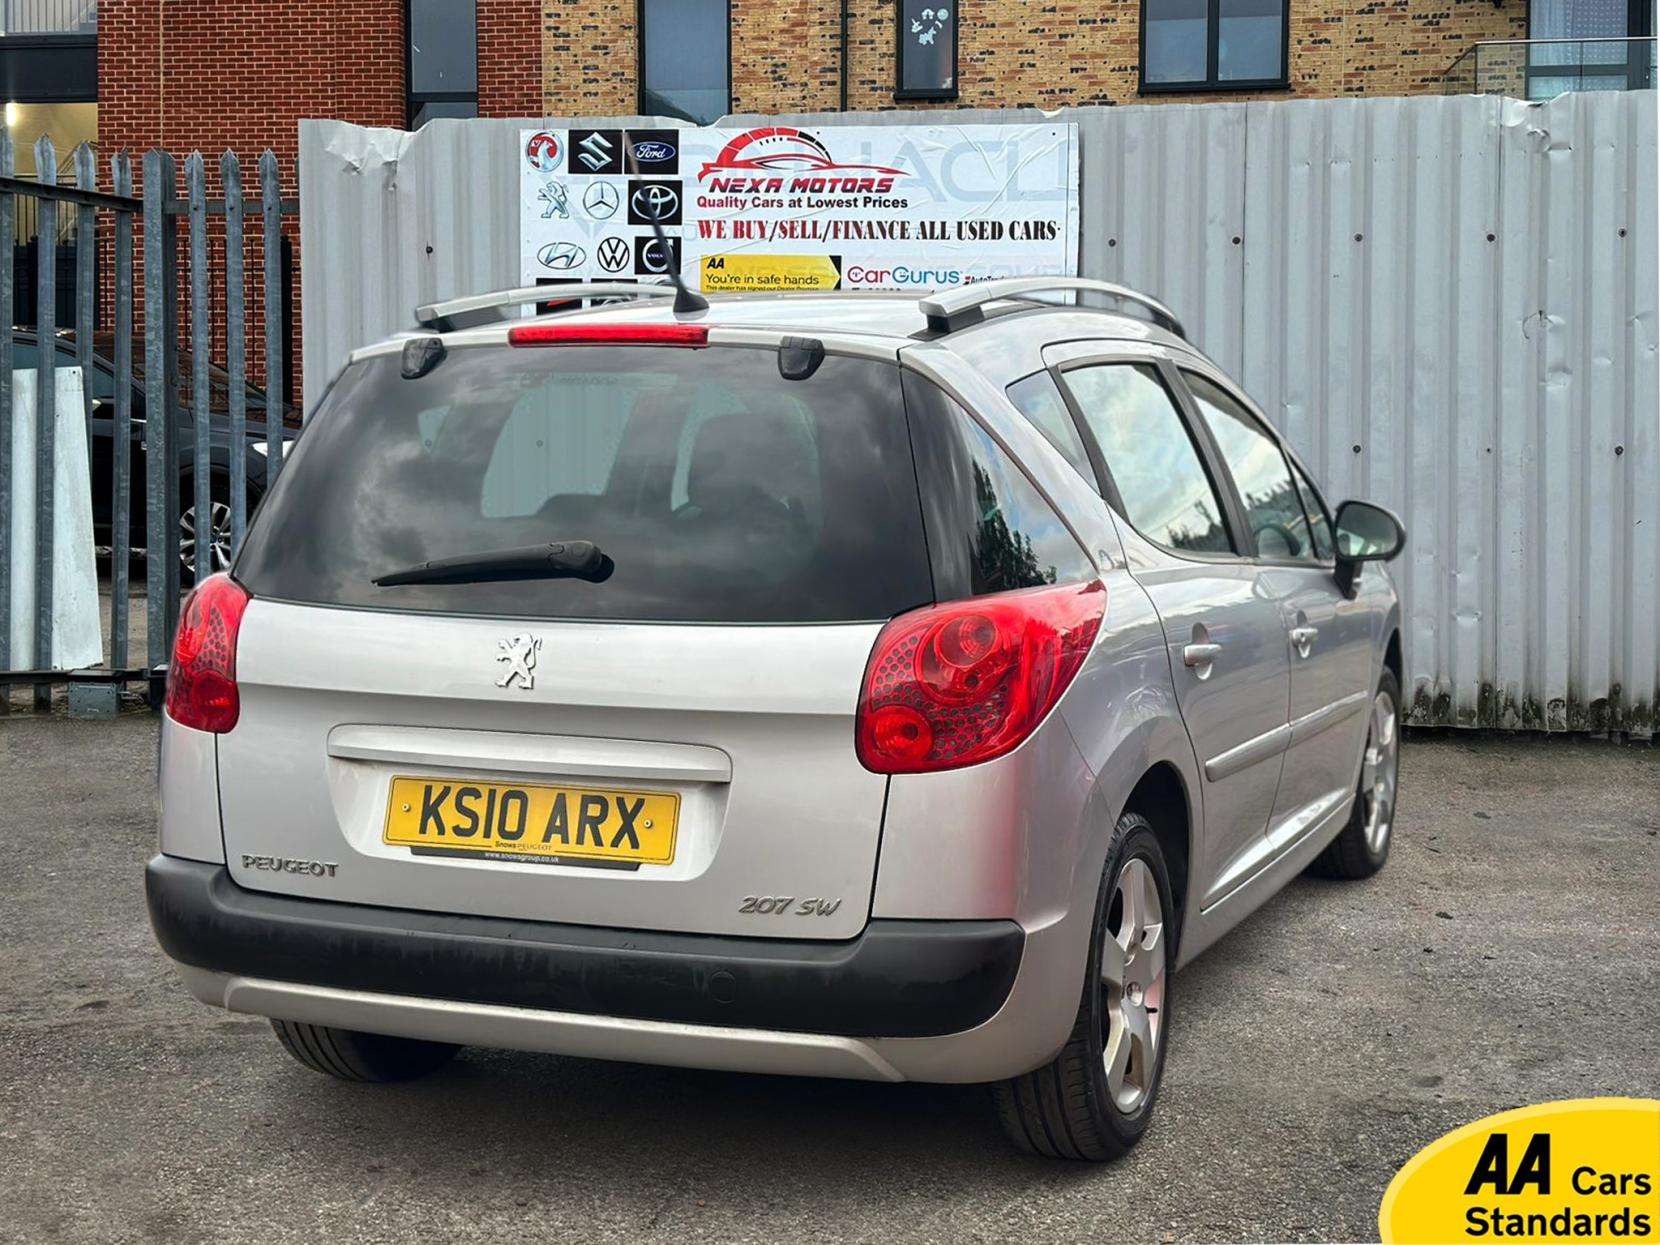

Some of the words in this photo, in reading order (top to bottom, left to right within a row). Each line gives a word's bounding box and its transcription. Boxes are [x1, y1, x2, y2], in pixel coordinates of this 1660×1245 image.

[636, 144, 666, 159] Ford
[708, 177, 784, 194] NEXA
[789, 177, 895, 194] MOTORS
[697, 196, 747, 211] Quality
[751, 196, 784, 209] Cars
[788, 197, 803, 209] at
[807, 196, 859, 209] Lowest
[862, 196, 909, 209] Prices
[697, 219, 727, 240] WE
[732, 219, 911, 243] BUY/SELL/FINANCE
[917, 220, 951, 241] ALL
[956, 220, 1004, 241] USED
[1008, 220, 1057, 241] CARS
[706, 257, 725, 269] AA
[706, 274, 741, 285] You're
[743, 275, 755, 284] in
[757, 275, 782, 285] safe
[783, 275, 820, 286] hands
[846, 266, 960, 284] CarGurus
[418, 784, 529, 841] KS10
[541, 793, 646, 850] ARX
[241, 854, 339, 877] PEUGEOT
[738, 896, 795, 915] 207
[795, 897, 842, 916] SW
